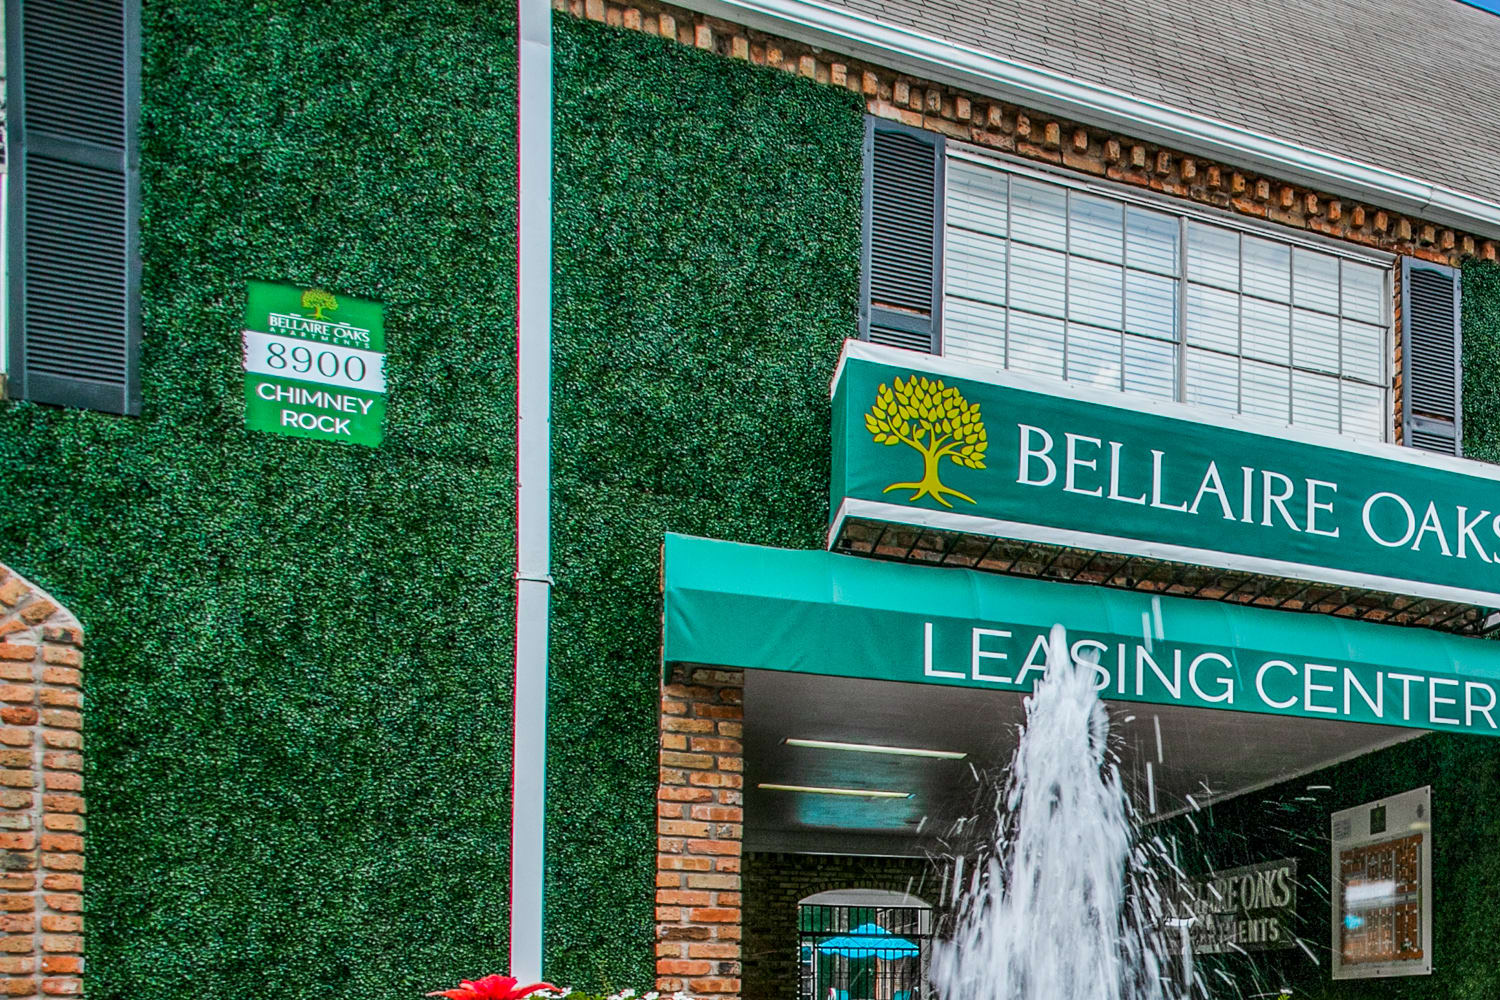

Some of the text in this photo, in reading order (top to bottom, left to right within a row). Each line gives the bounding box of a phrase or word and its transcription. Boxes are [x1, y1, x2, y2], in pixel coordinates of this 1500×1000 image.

[269, 314, 371, 344] BELLAIRE OAKS
[269, 327, 371, 350] APARTMENTS
[265, 342, 367, 382] 8900
[256, 382, 374, 416] CHIMNEY
[281, 409, 352, 436] ROCK
[1015, 423, 1340, 538] BELLAIRE
[924, 622, 1499, 730] LEASING CENTER
[1240, 866, 1291, 911] OAKS
